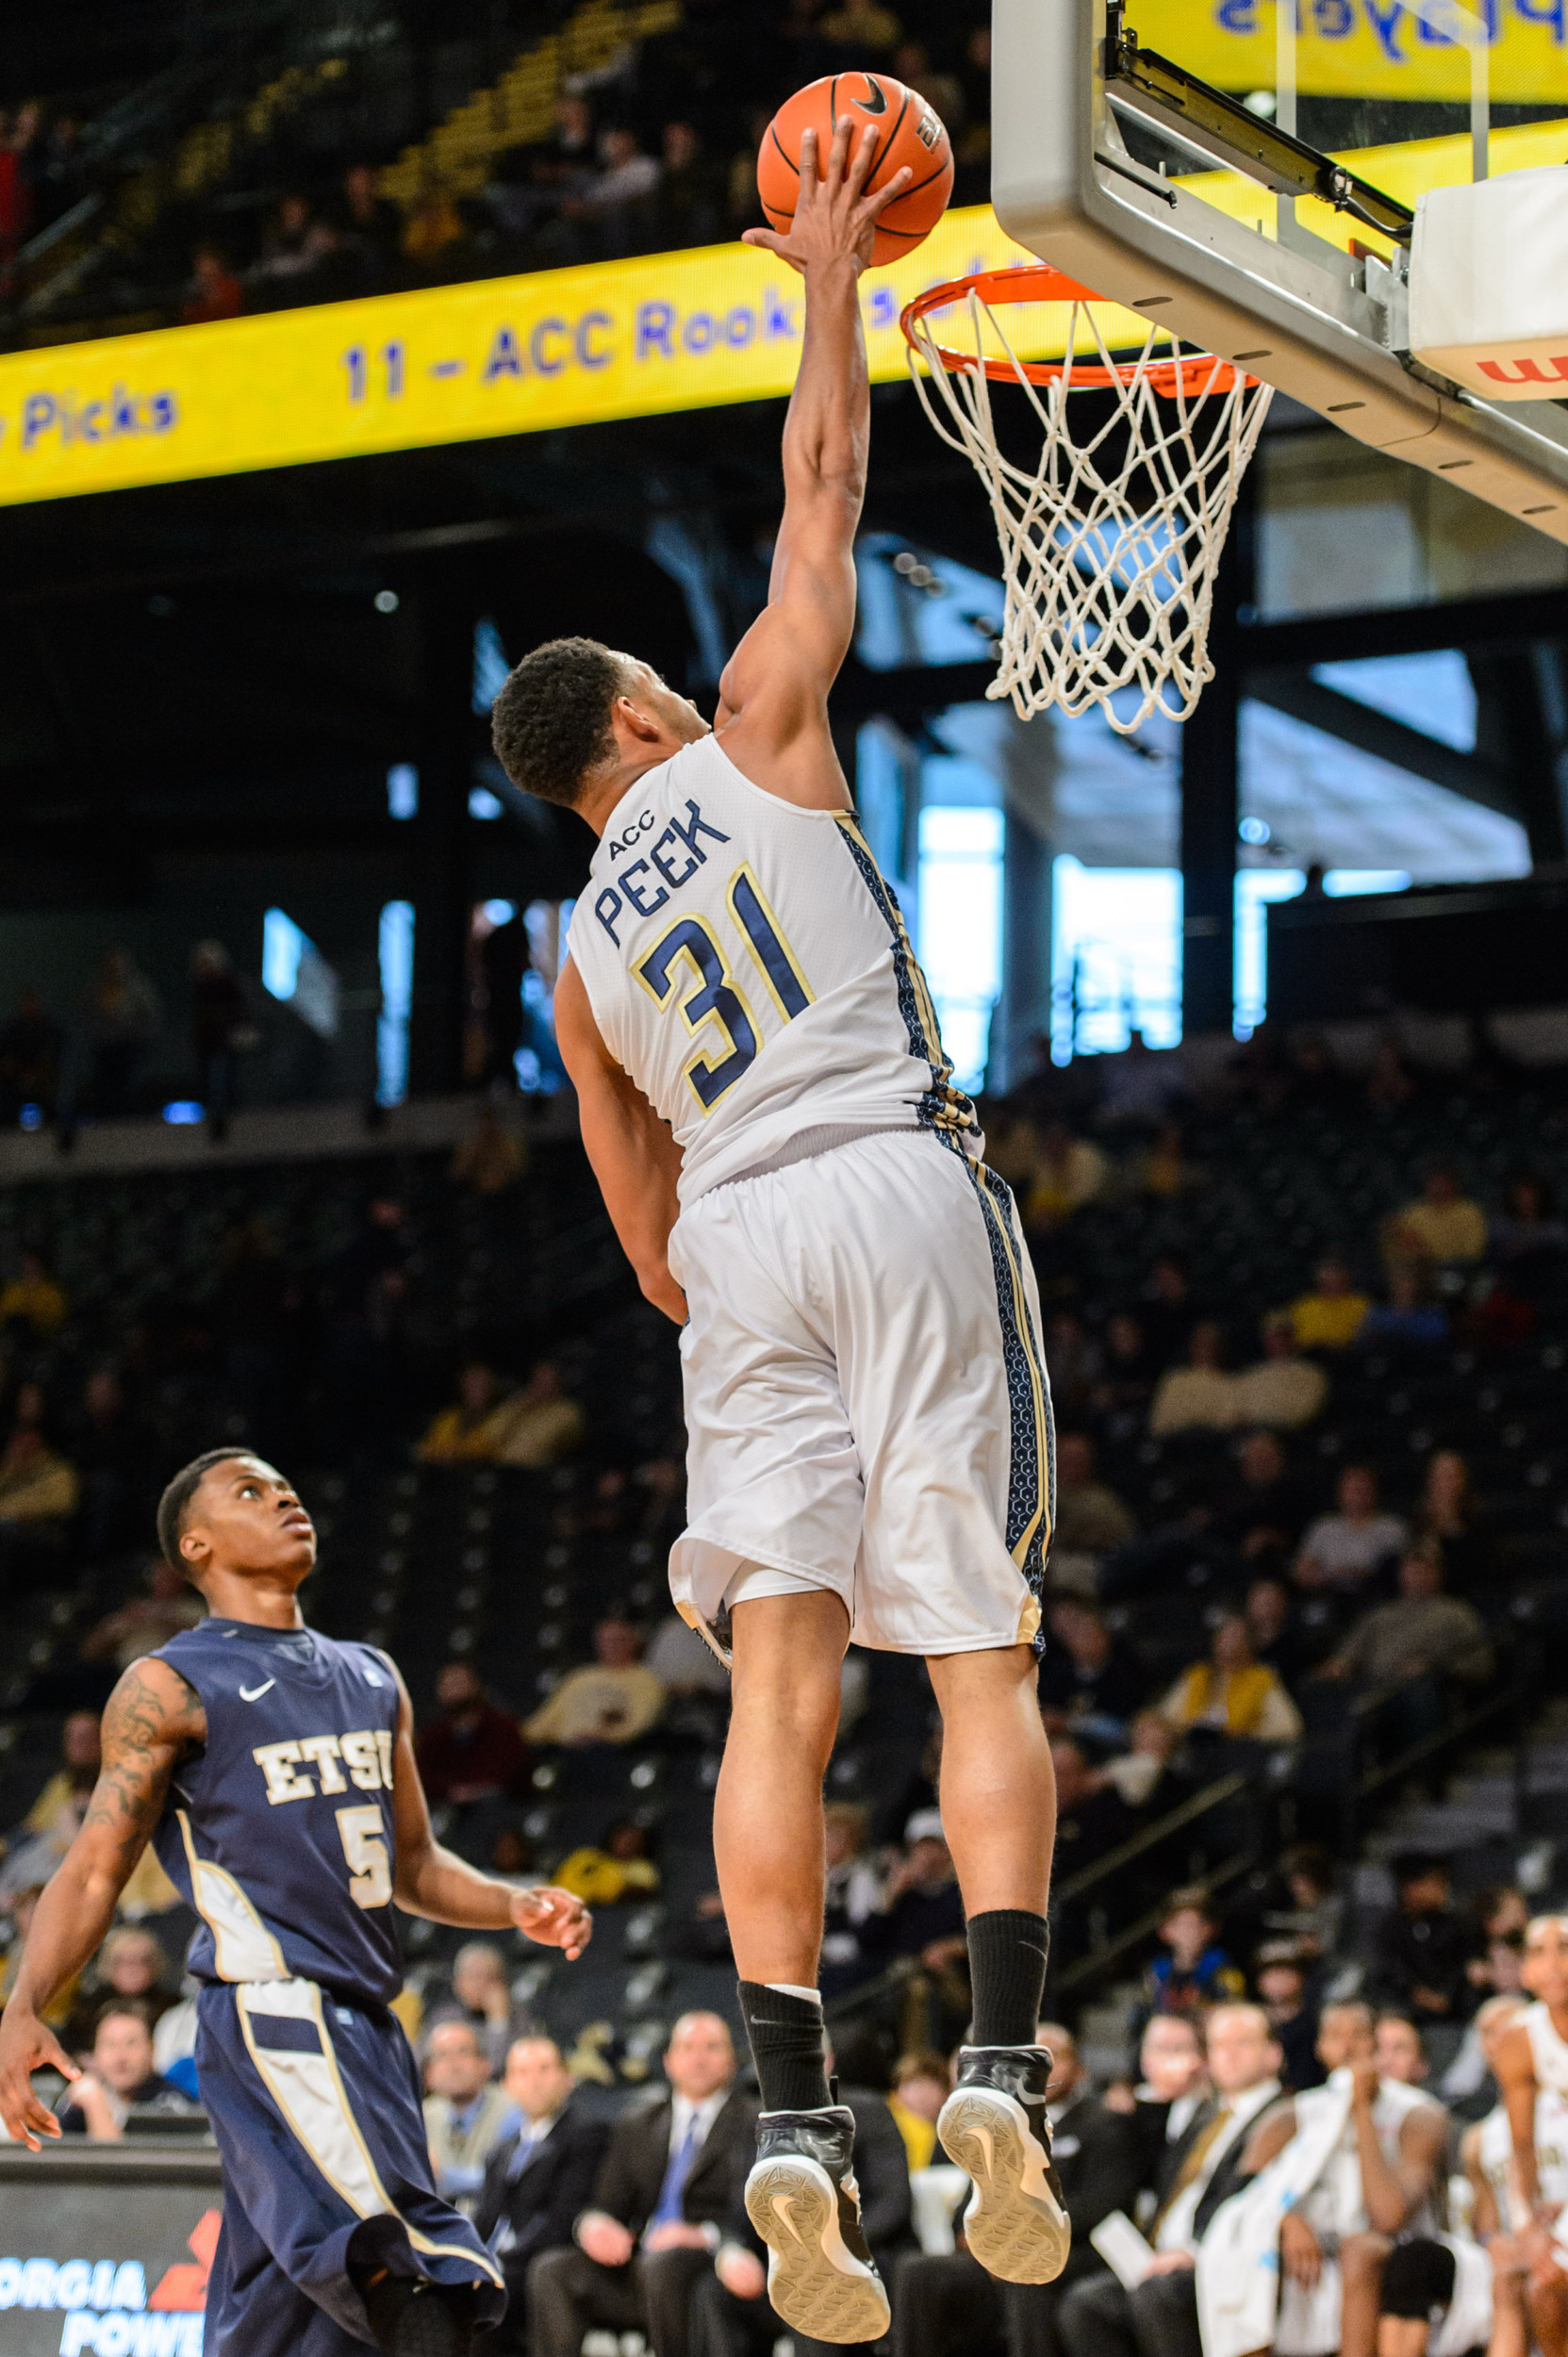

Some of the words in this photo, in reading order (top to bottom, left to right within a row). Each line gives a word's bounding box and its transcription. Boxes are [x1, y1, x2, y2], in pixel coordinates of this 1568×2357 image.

[25, 381, 178, 451] Picks
[341, 339, 405, 405] 11
[482, 310, 615, 385] ACC
[595, 799, 731, 950] PEEK
[608, 809, 655, 861] ACC
[629, 860, 817, 1119] 31
[335, 1805, 393, 1910] 5
[58, 2309, 206, 2357] POWE
